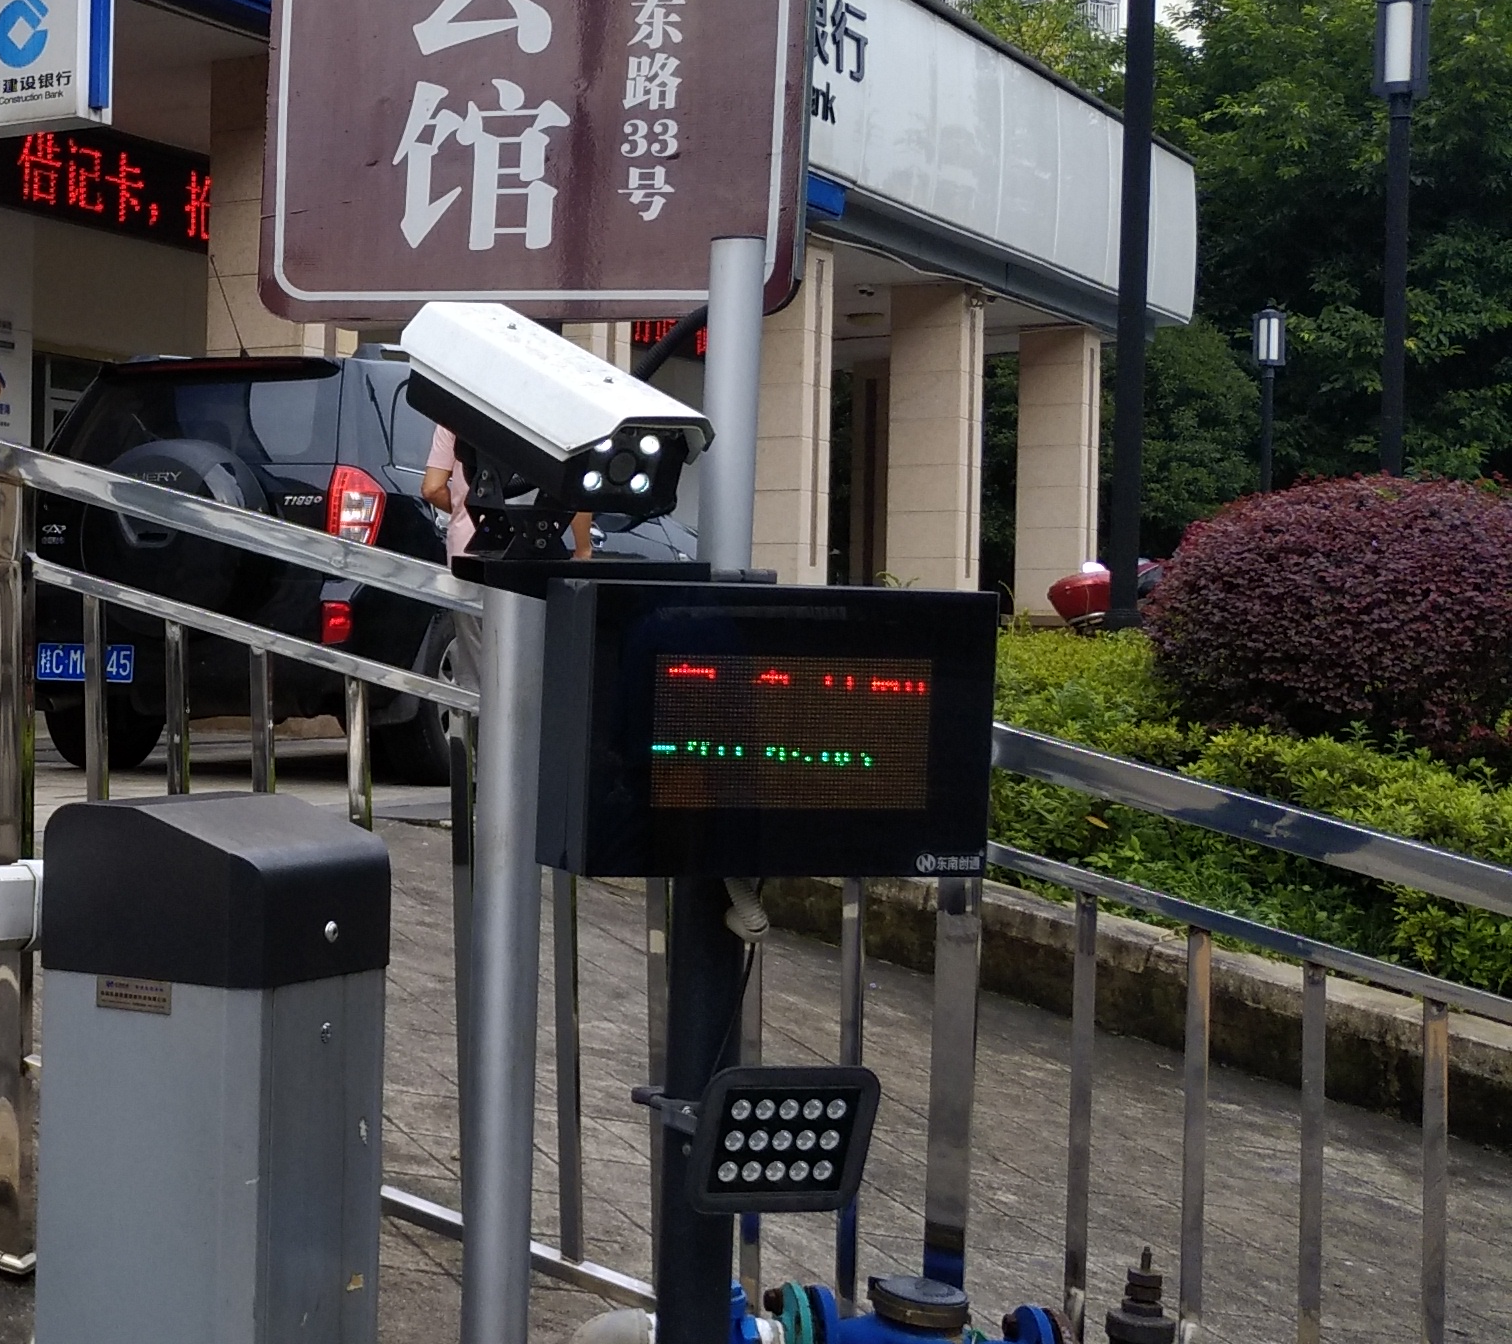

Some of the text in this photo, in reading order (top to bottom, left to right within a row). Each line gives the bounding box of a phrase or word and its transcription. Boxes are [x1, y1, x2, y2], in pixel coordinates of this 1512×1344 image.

[0, 93, 42, 105] Construction
[44, 90, 64, 99] Bank
[40, 648, 132, 677] 桂C·M45
